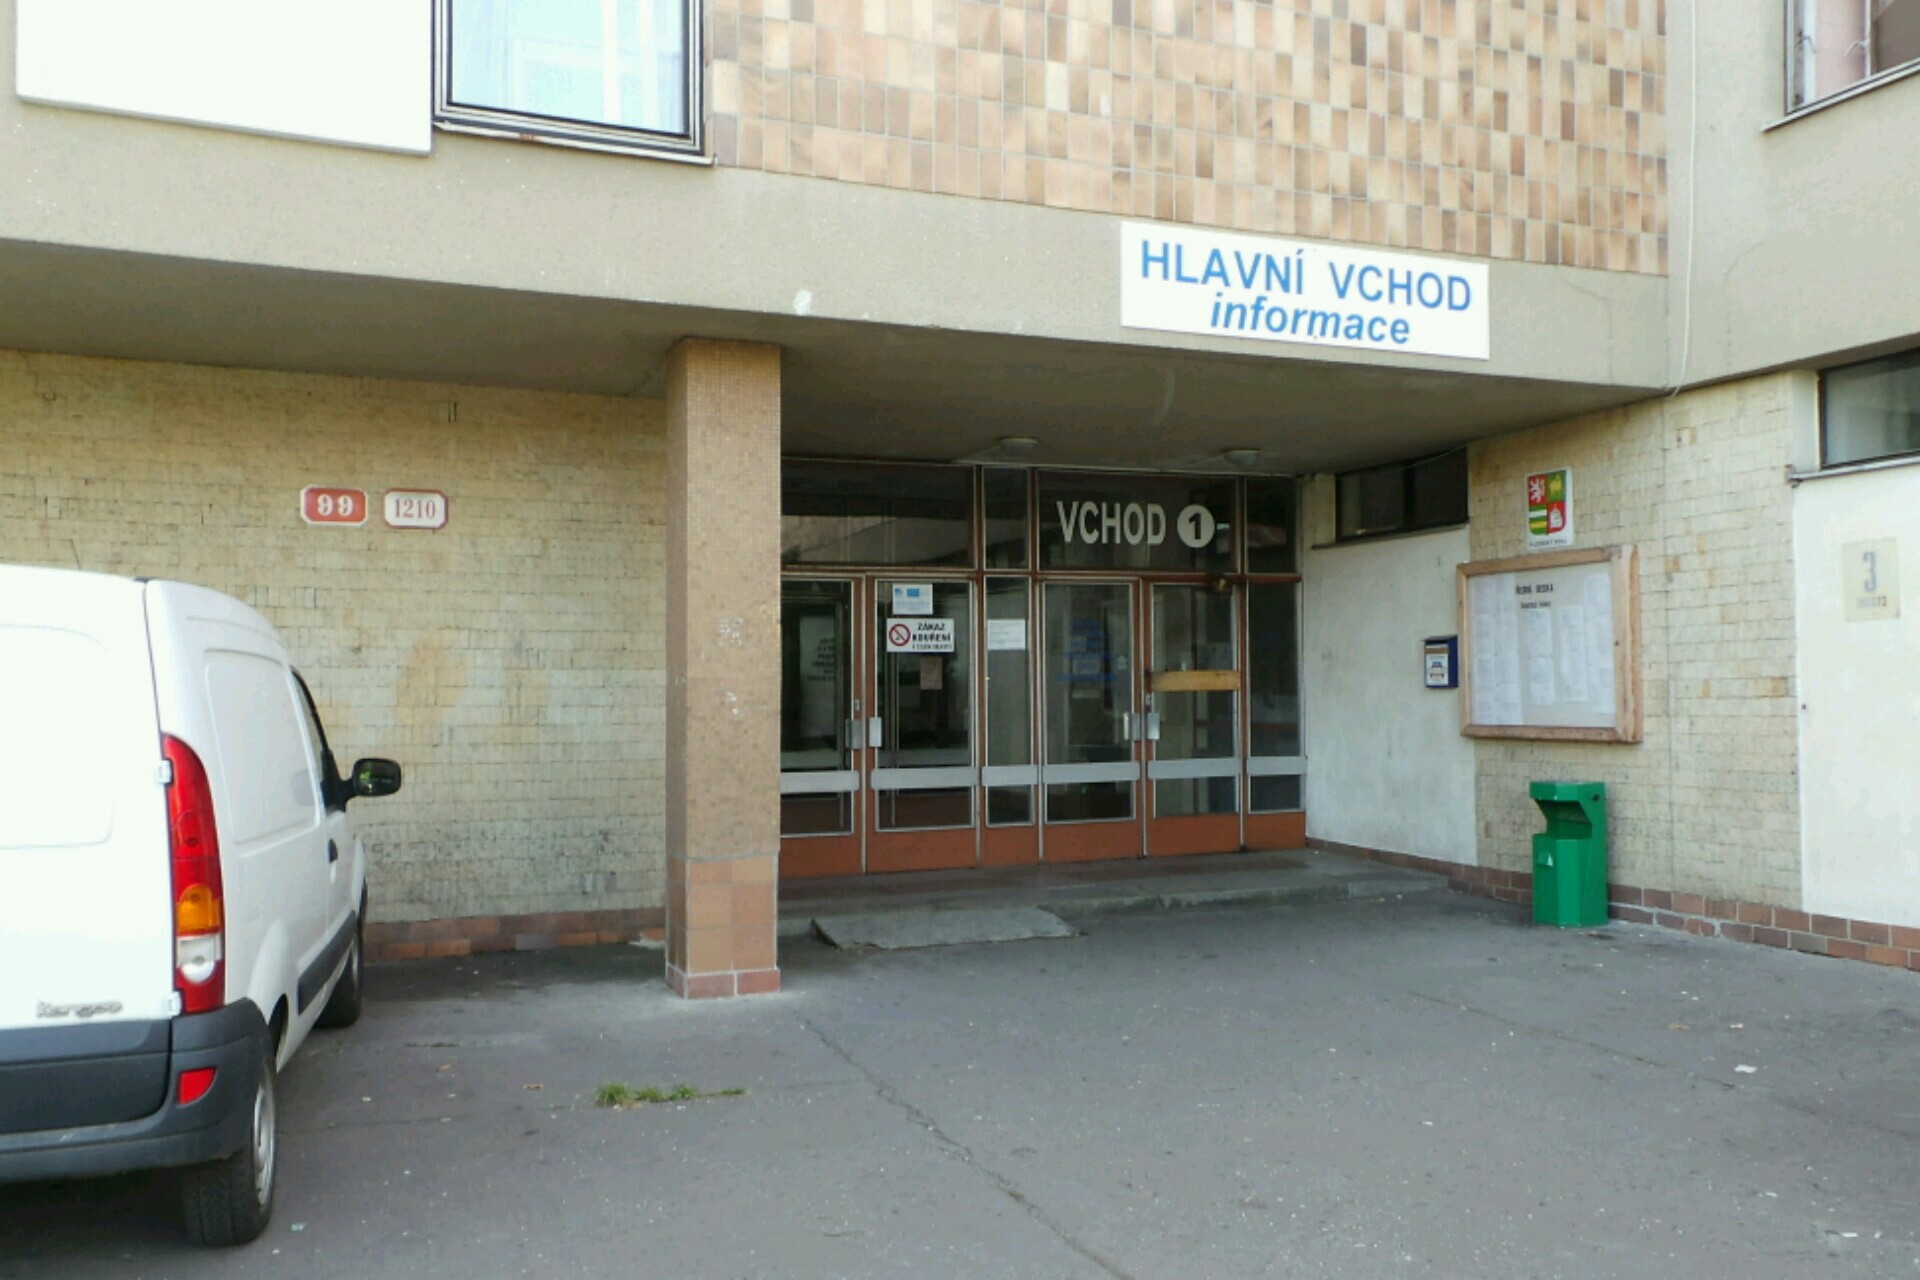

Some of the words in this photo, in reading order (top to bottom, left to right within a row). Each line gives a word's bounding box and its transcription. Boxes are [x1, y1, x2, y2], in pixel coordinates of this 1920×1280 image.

[1140, 240, 1304, 295] HLAVNÍ
[1328, 261, 1471, 311] VCHOD
[1210, 292, 1410, 344] informace
[317, 494, 354, 516] 99
[394, 498, 436, 518] 1210
[1057, 501, 1166, 544] VCHOD
[1862, 551, 1877, 592] 3
[917, 621, 946, 631] ZÁKAZ
